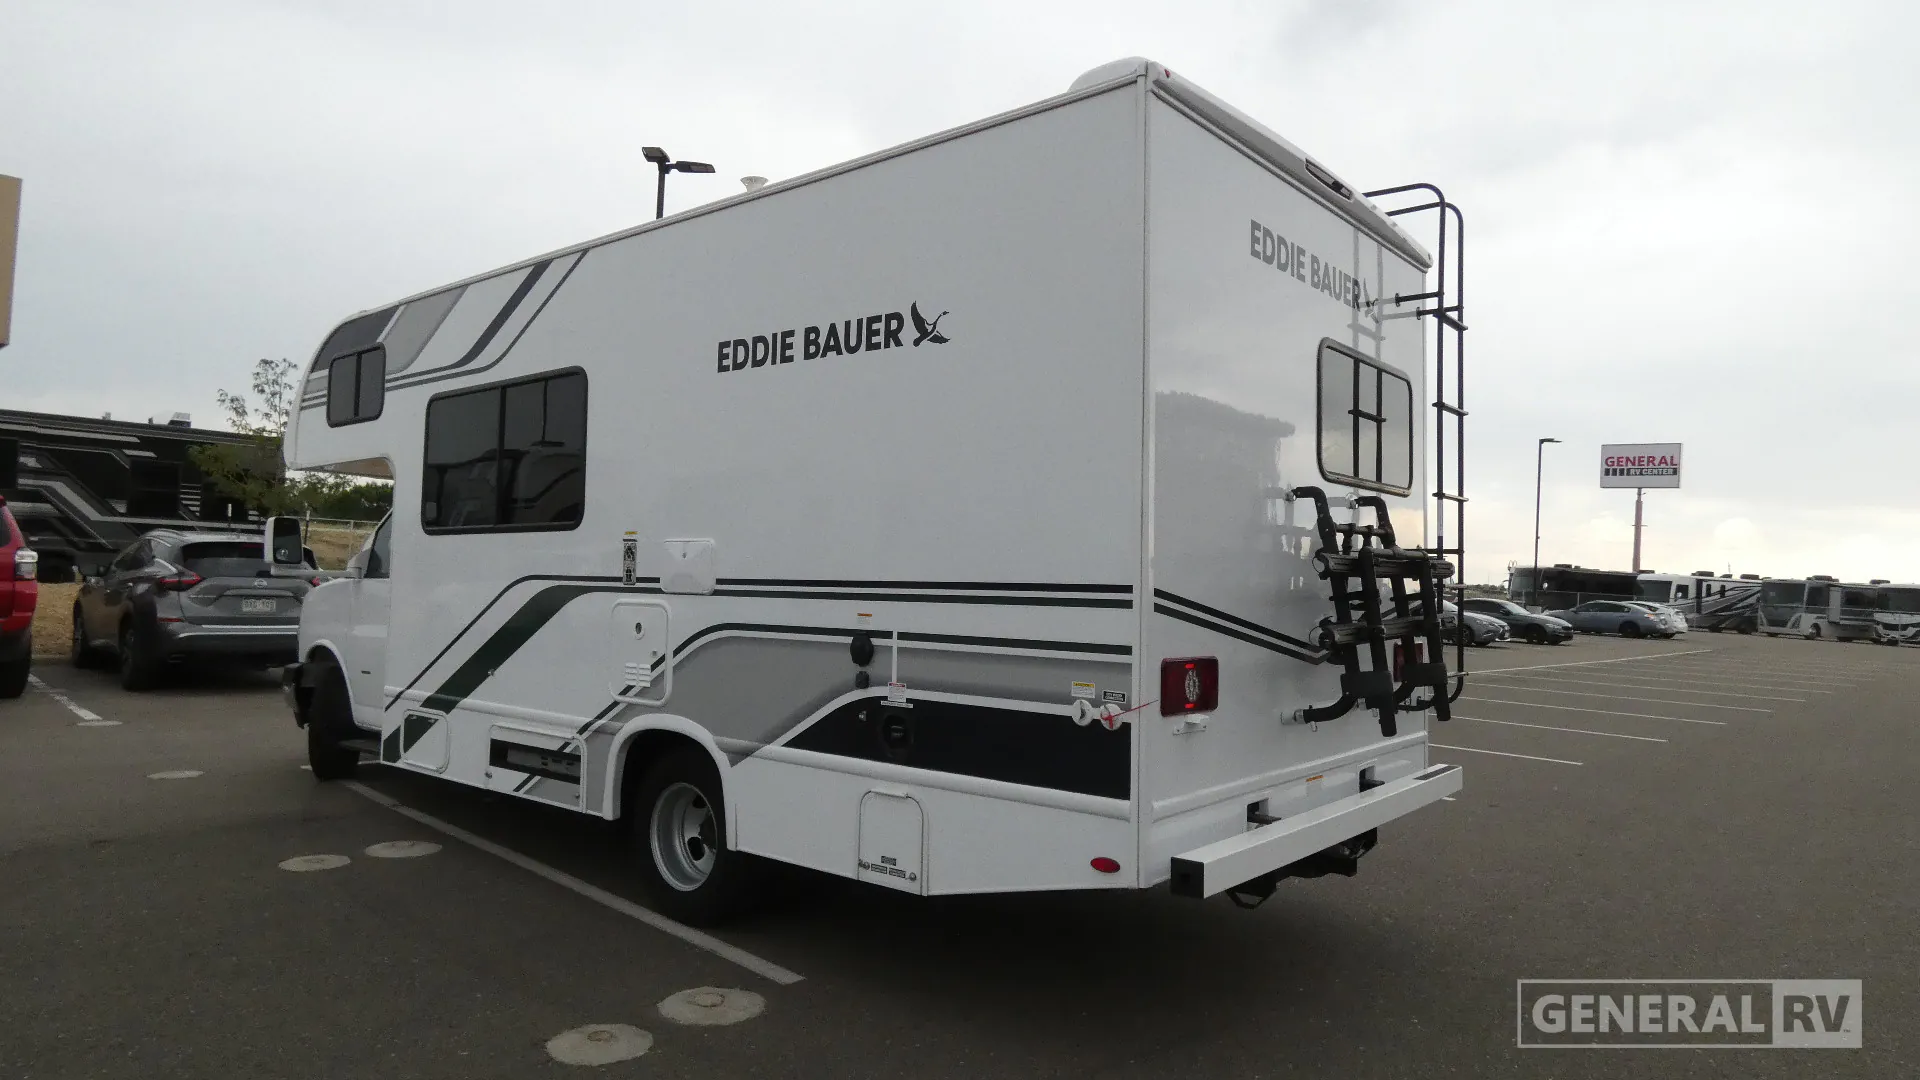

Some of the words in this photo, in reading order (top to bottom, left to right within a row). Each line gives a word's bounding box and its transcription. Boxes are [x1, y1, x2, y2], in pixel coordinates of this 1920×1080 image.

[1250, 219, 1305, 283] EDDIE
[1310, 253, 1361, 312] BAUER
[717, 329, 796, 373] EDDIE
[803, 311, 905, 361] BAUER
[1604, 455, 1678, 467] GENERAL
